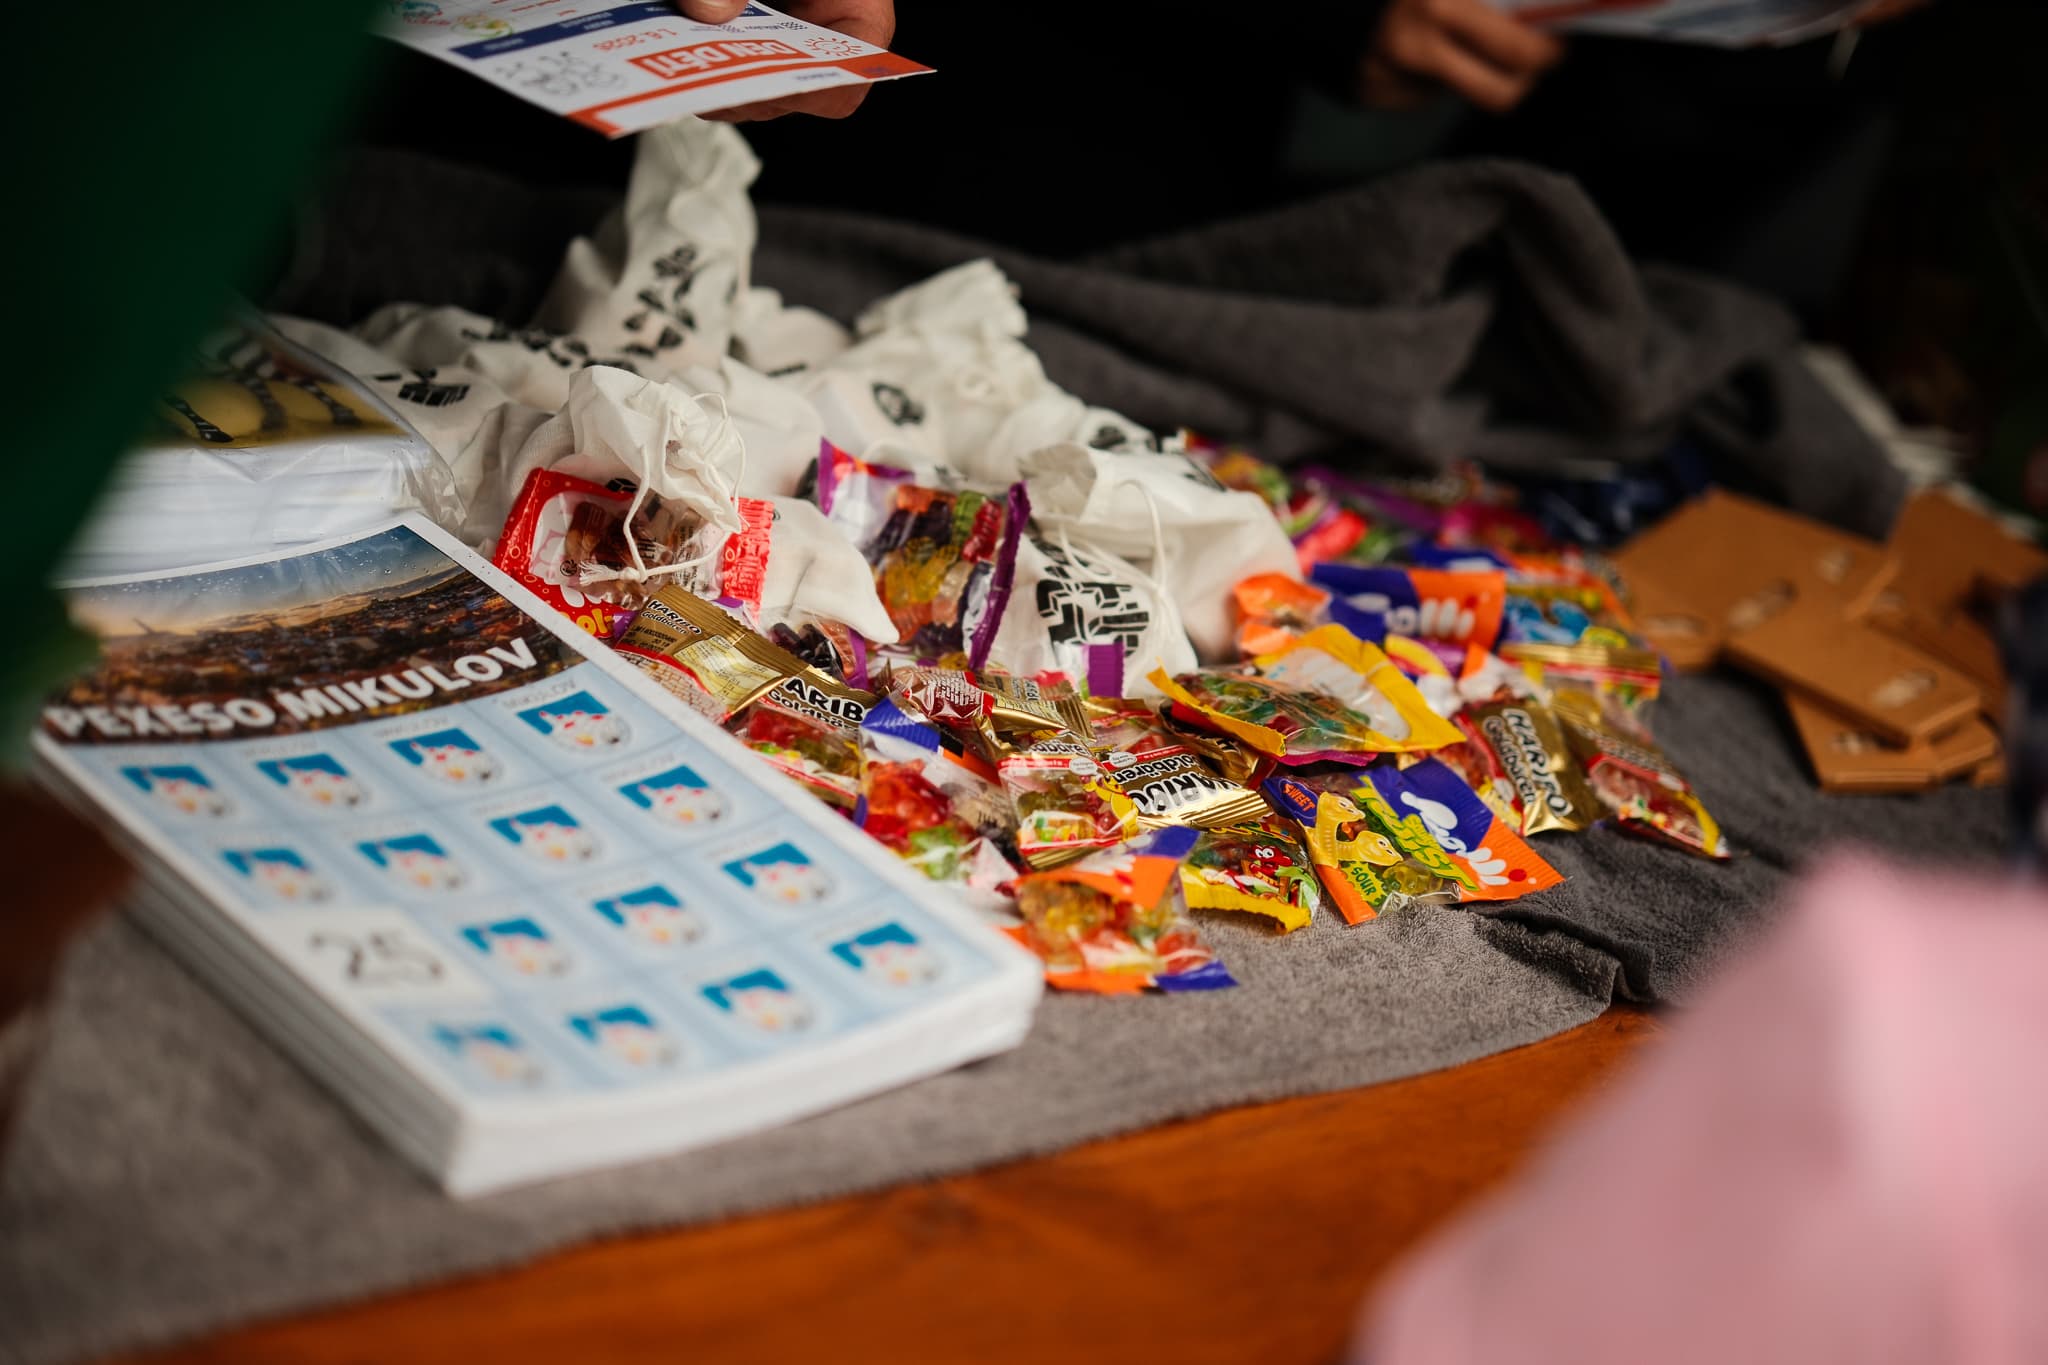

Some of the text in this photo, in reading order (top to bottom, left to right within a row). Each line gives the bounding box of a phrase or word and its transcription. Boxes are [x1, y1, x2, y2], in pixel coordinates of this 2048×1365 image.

[648, 600, 701, 634] HARIBO
[44, 637, 539, 738] PEXESO MIKULOV
[1282, 783, 1316, 812] SWEET
[1351, 866, 1377, 896] SOUR
